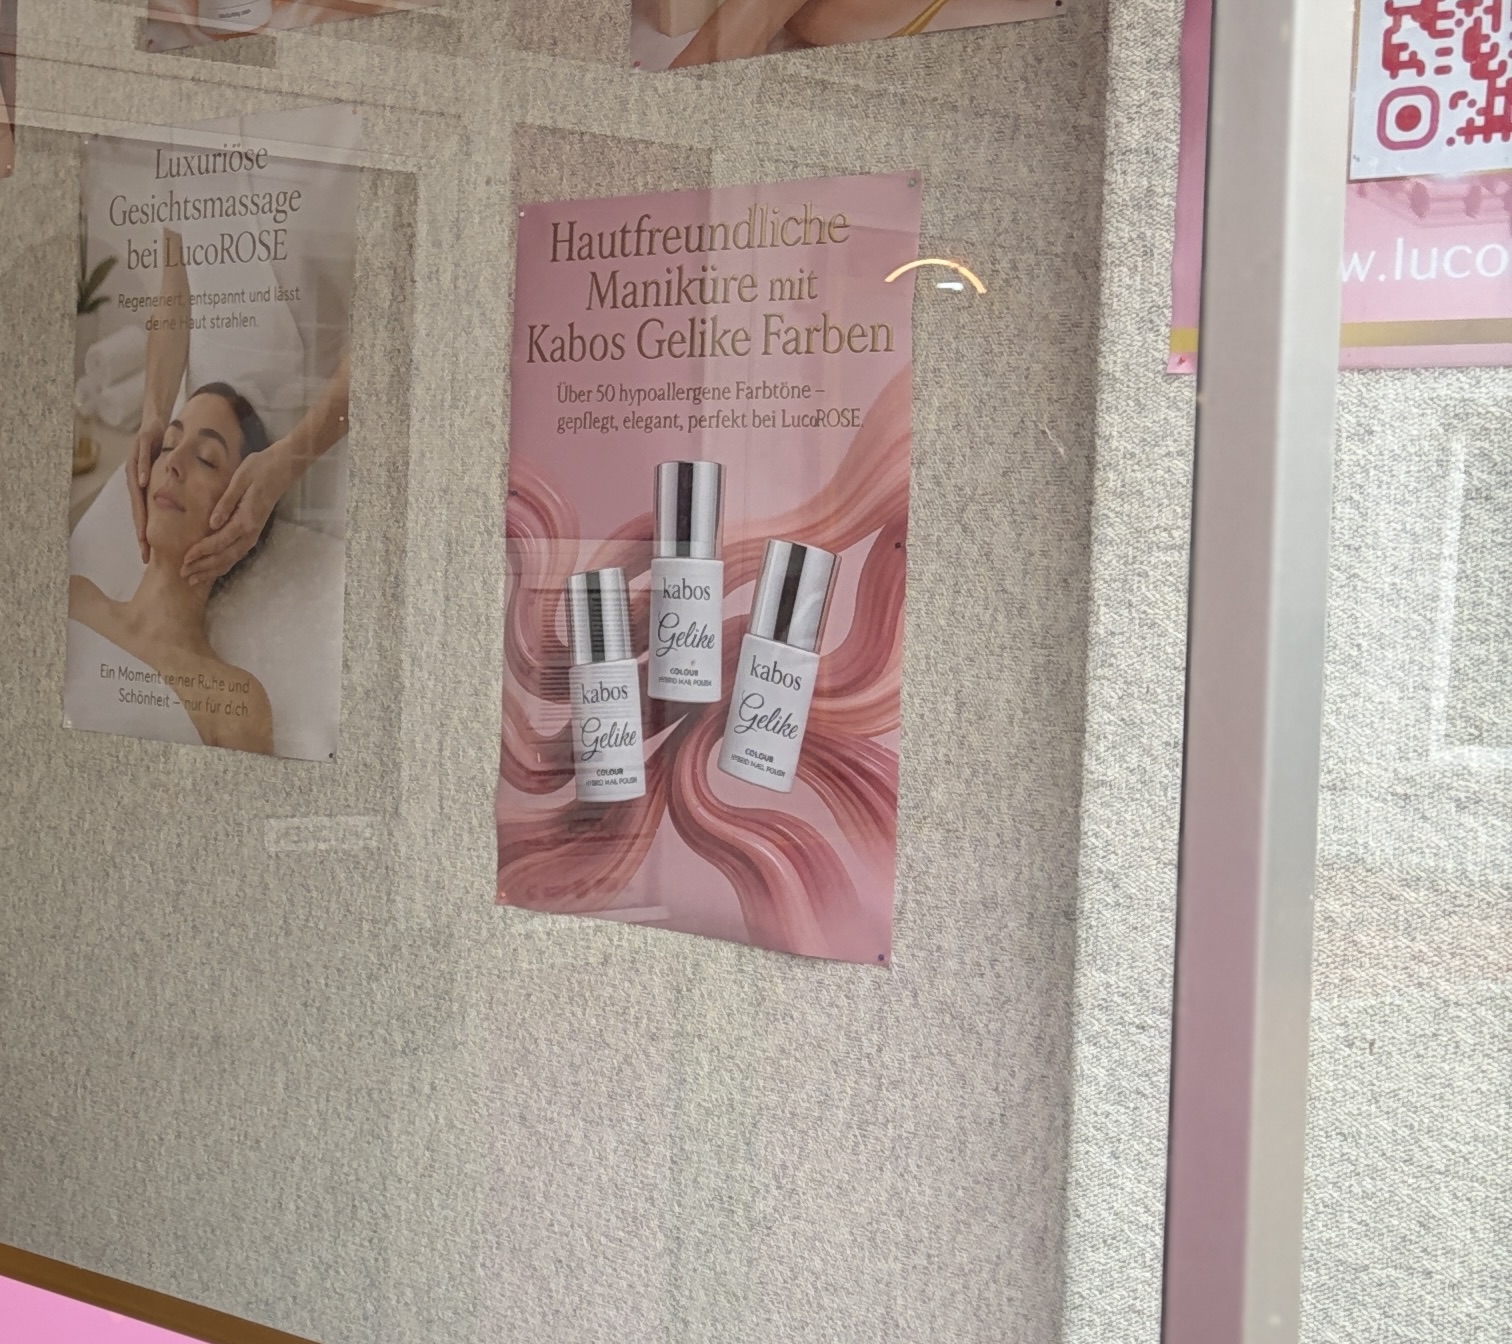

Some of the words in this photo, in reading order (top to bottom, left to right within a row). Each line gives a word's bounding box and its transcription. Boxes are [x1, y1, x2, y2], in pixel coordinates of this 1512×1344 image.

[155, 143, 268, 180] Luxuriöse
[109, 188, 302, 227] Gesichtsmassage
[127, 239, 158, 270] bei
[166, 229, 288, 268] LucoROSE
[549, 201, 851, 263] Hautfreundliche
[585, 264, 758, 311] Maniküre
[768, 268, 818, 301] mit
[526, 322, 626, 364] Kabos
[636, 315, 752, 360] Gelike
[761, 310, 895, 356] Farben
[557, 382, 591, 404] Über
[595, 384, 615, 402] 50
[619, 383, 731, 404] hypoallergene
[735, 381, 811, 400] Farbtöne
[557, 412, 619, 435] gepflegt,
[623, 411, 684, 432] elegant,
[688, 410, 747, 433] perfekt
[752, 409, 777, 429] bei
[781, 408, 864, 429] LucoROSE.
[661, 577, 711, 602] kabos
[656, 609, 716, 657] Gelike
[100, 664, 115, 678] Ein
[118, 666, 161, 684] Moment
[164, 673, 195, 687] reiner
[198, 674, 225, 692] Ruhe
[228, 679, 250, 694] und
[750, 655, 802, 692] kabos
[580, 682, 629, 705] kabos
[734, 690, 799, 740] Gelike
[580, 716, 637, 762] Gelike
